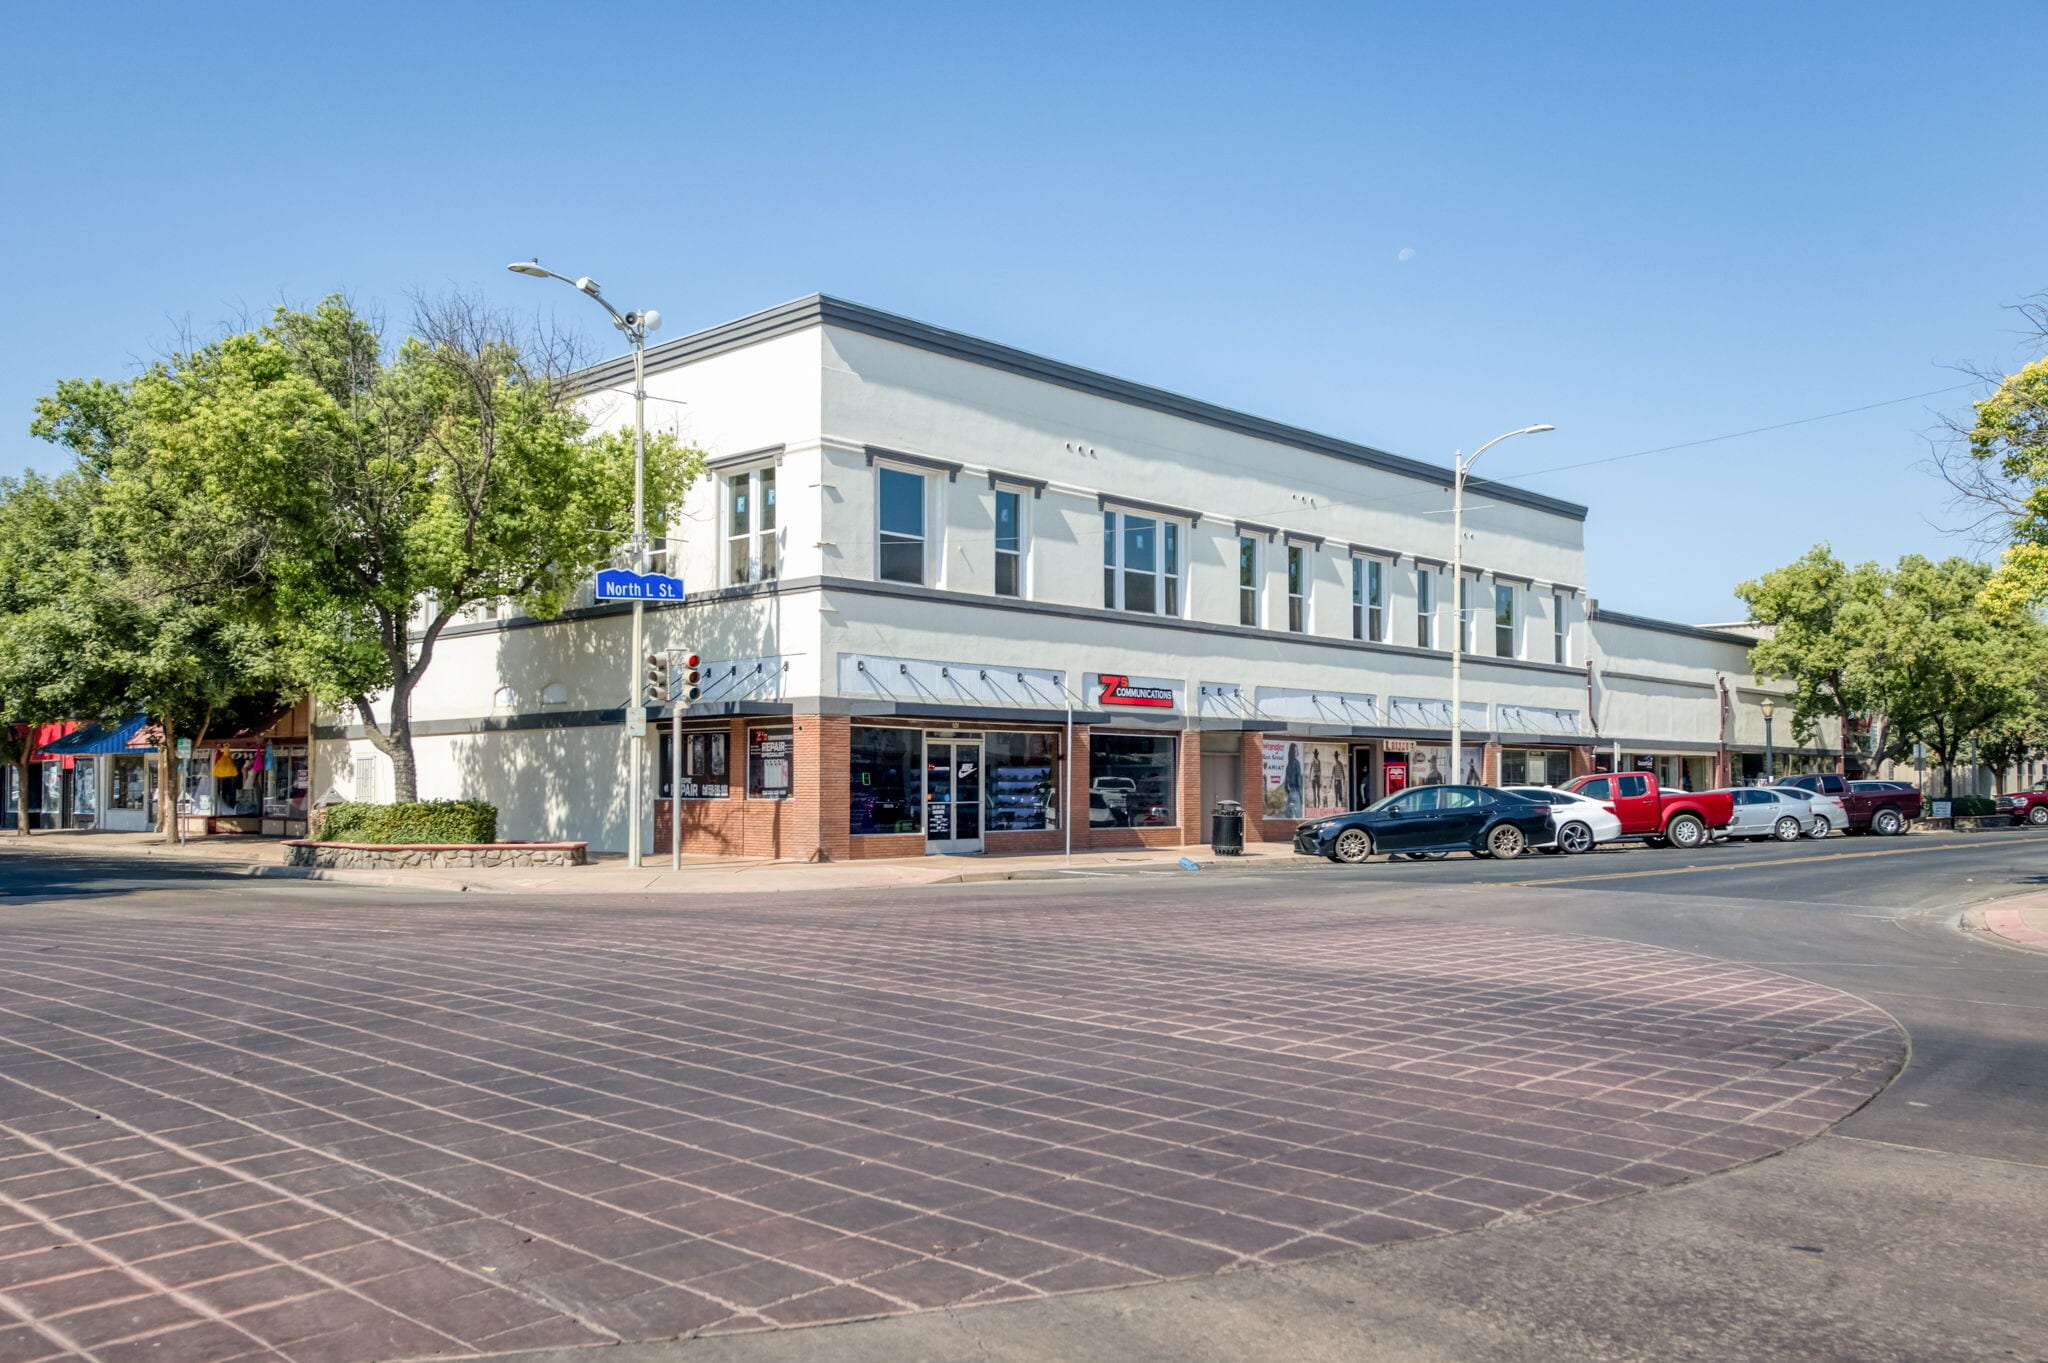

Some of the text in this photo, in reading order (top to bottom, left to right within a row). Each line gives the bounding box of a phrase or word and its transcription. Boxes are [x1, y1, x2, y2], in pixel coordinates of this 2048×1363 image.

[606, 581, 676, 598] North L St.
[1116, 688, 1172, 699] COMMUNICATIONS
[761, 741, 785, 752] REPAIR
